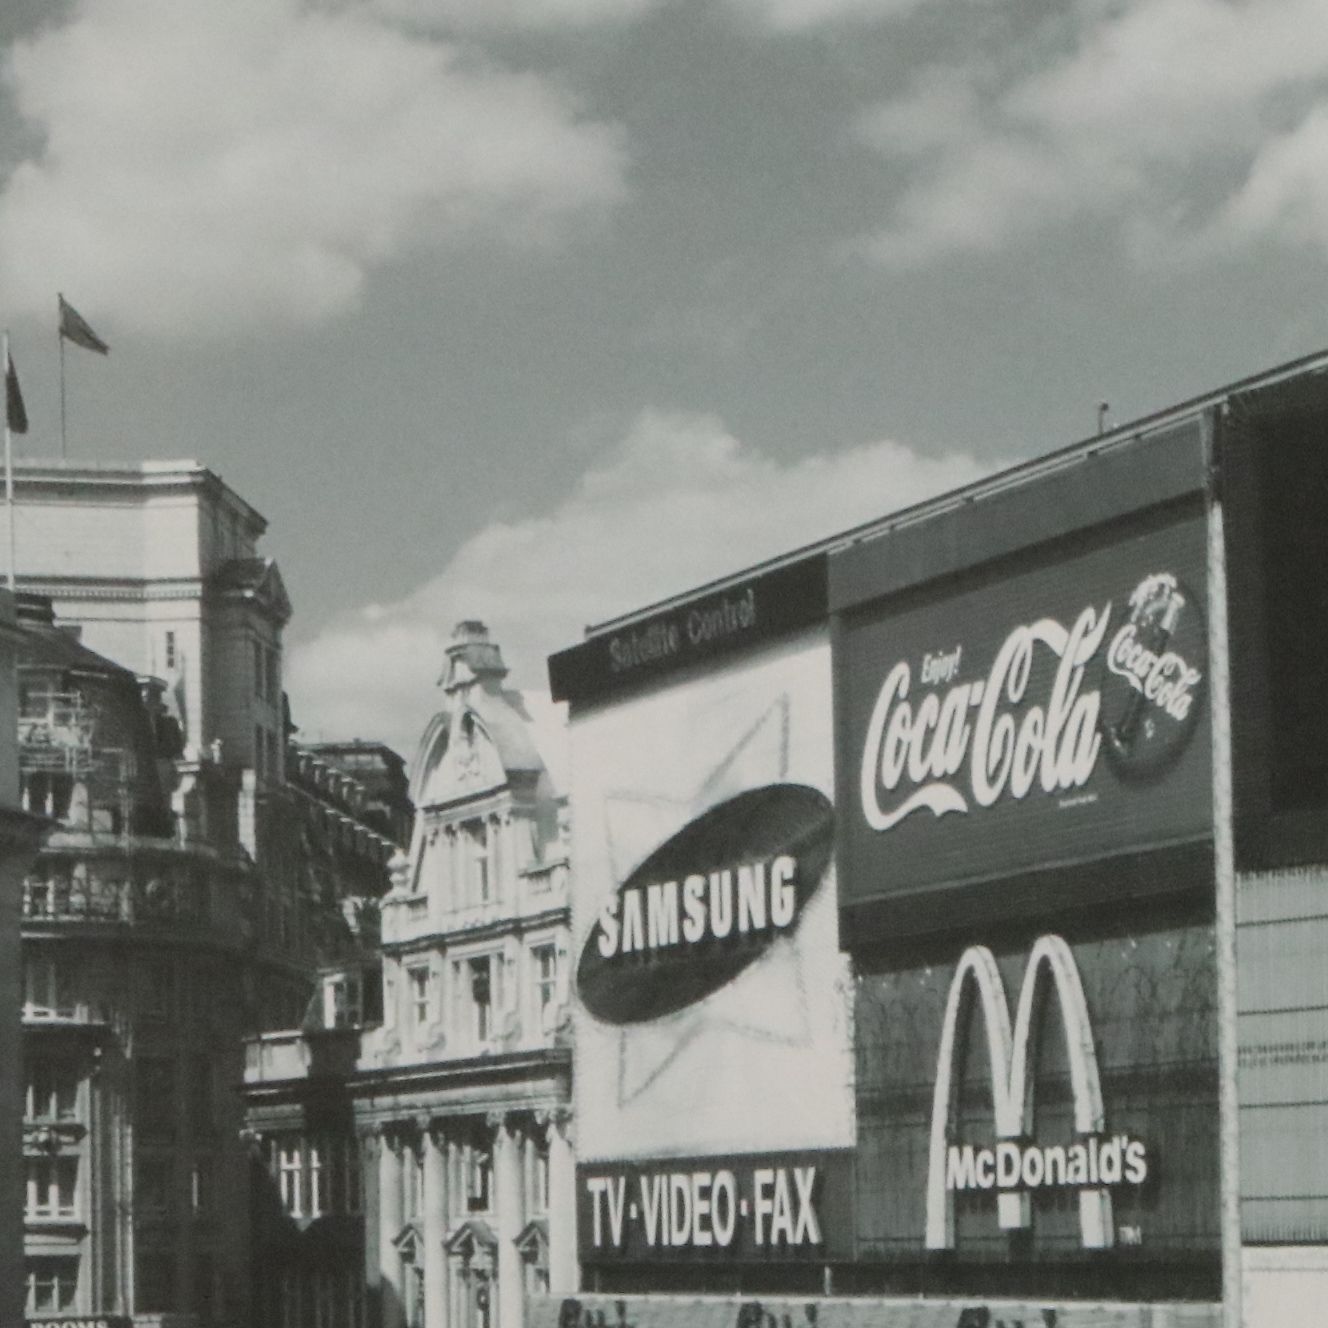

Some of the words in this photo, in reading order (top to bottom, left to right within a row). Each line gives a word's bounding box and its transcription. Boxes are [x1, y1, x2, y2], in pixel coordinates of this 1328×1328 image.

[921, 645, 962, 685] Enjoy!
[597, 854, 798, 958] SAMSUNG
[946, 1134, 1148, 1190] McDonald's
